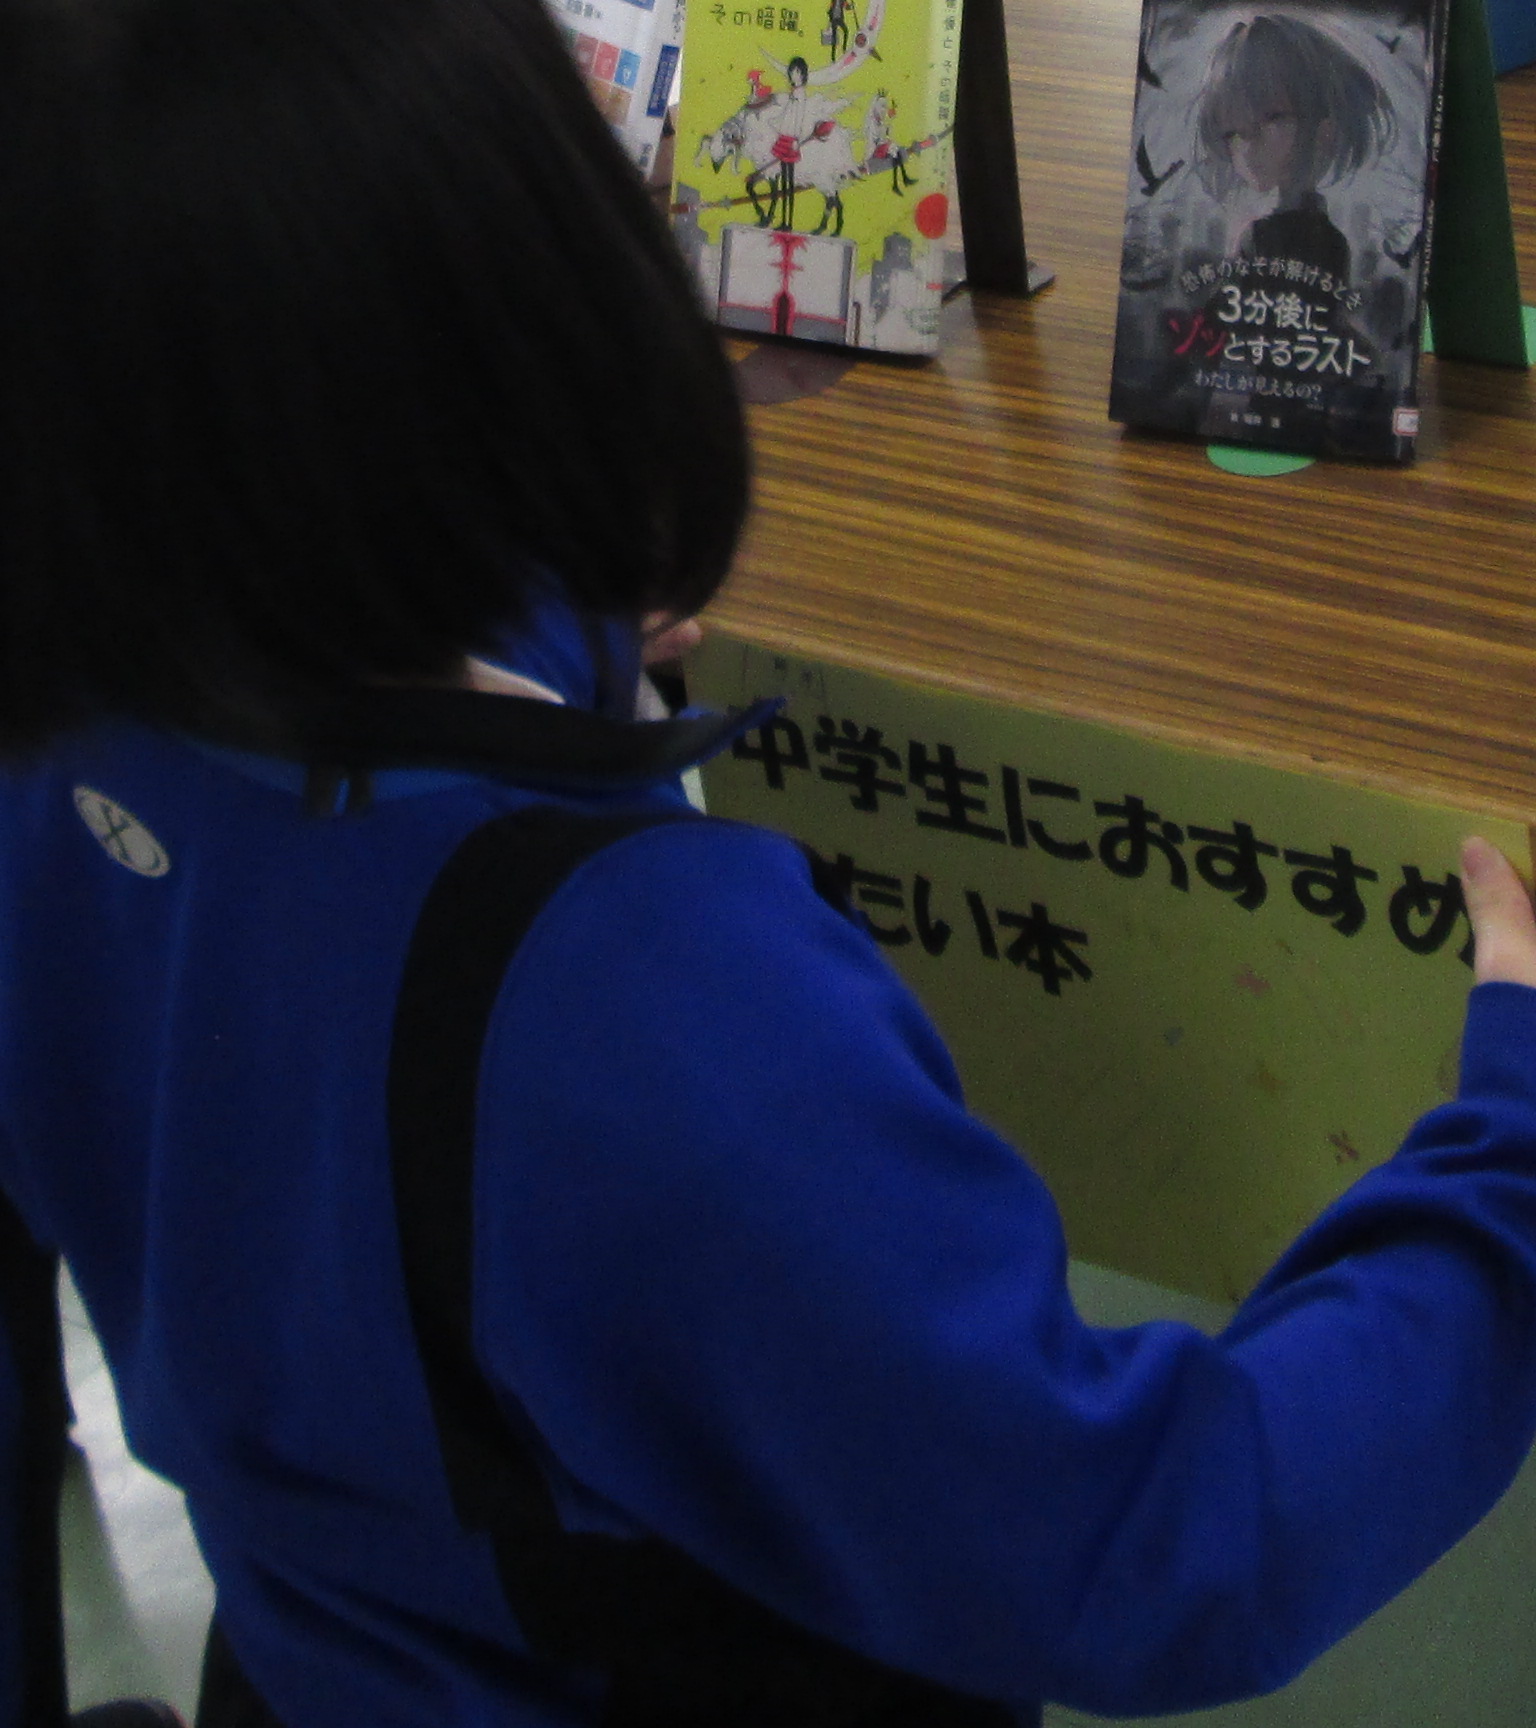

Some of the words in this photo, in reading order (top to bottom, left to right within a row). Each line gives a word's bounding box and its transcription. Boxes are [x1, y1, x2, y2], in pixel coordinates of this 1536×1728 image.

[1168, 308, 1372, 377] ゾッとするラスト
[1218, 285, 1329, 333] 3分後に
[728, 702, 1474, 970] 中学生におすすめ
